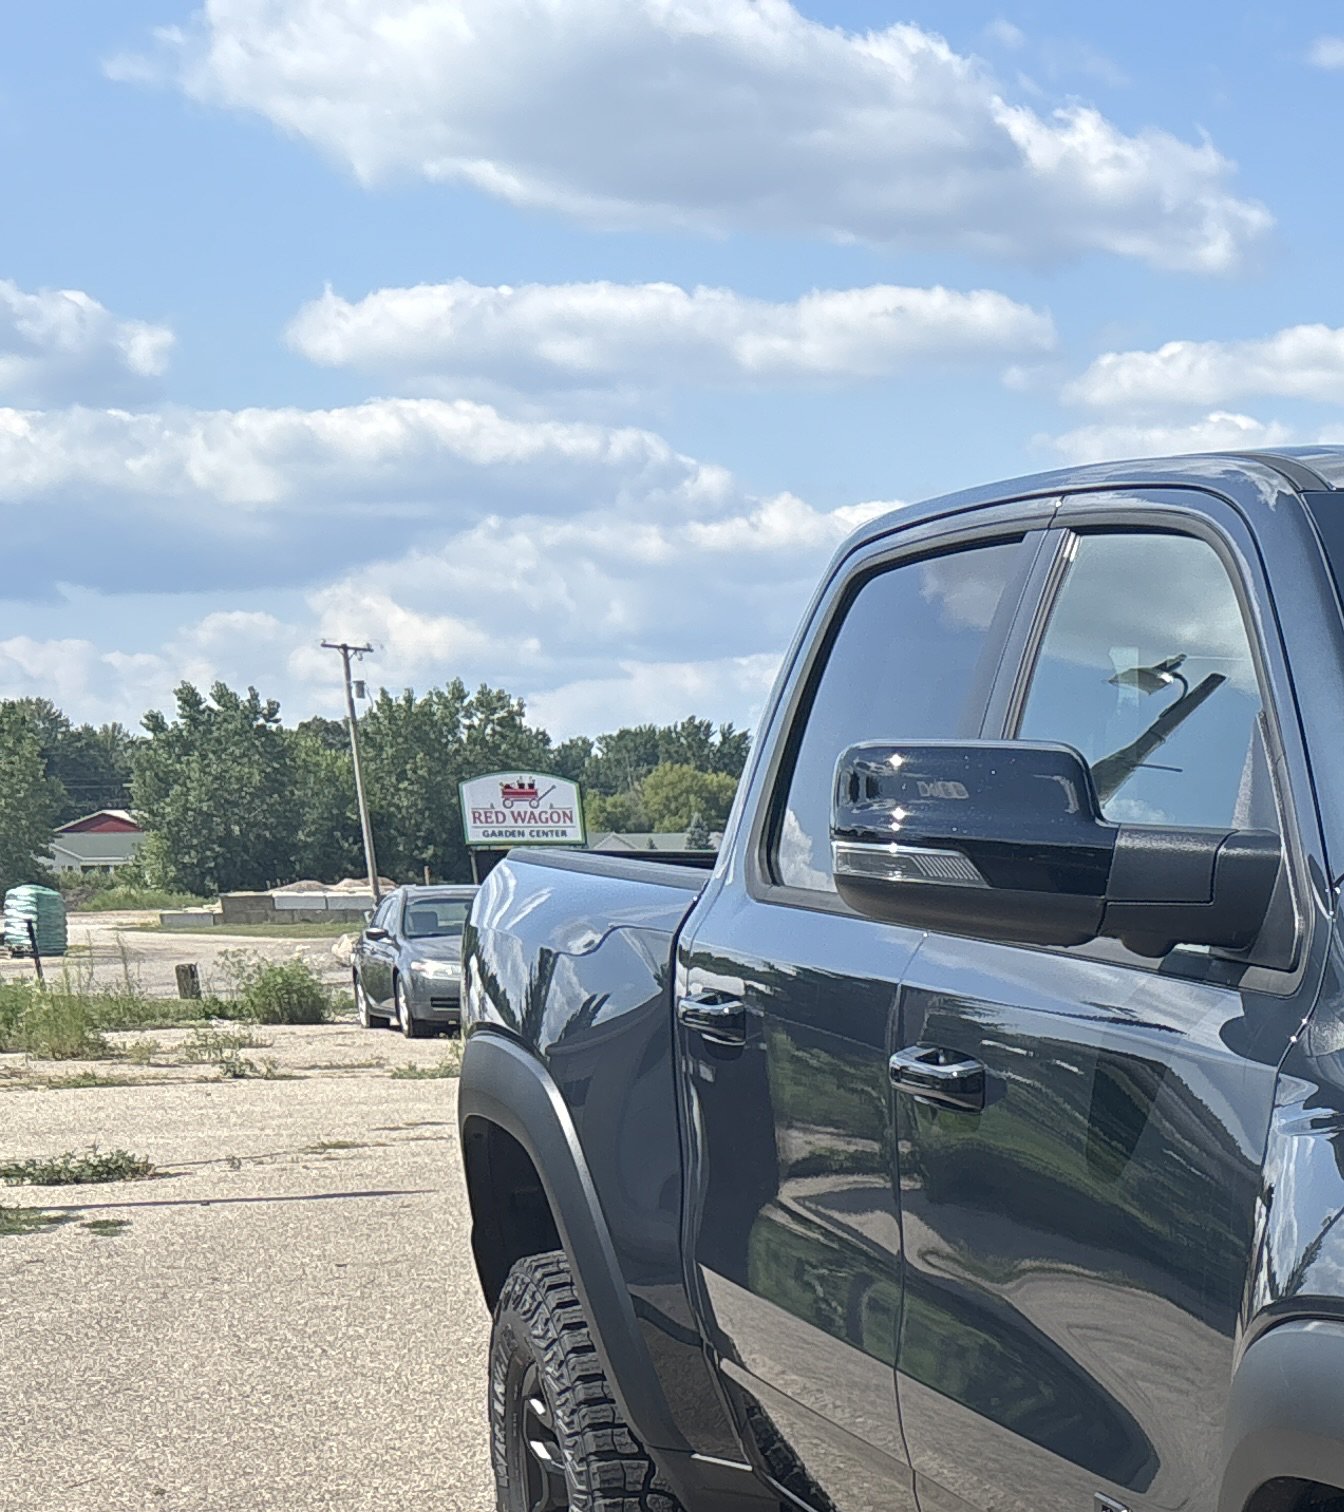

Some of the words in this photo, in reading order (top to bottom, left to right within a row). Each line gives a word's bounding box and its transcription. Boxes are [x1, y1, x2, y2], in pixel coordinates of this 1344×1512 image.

[473, 811, 506, 824] RED
[510, 810, 573, 824] WAGON
[482, 829, 525, 839] GARDEN
[529, 829, 568, 839] CENTER
